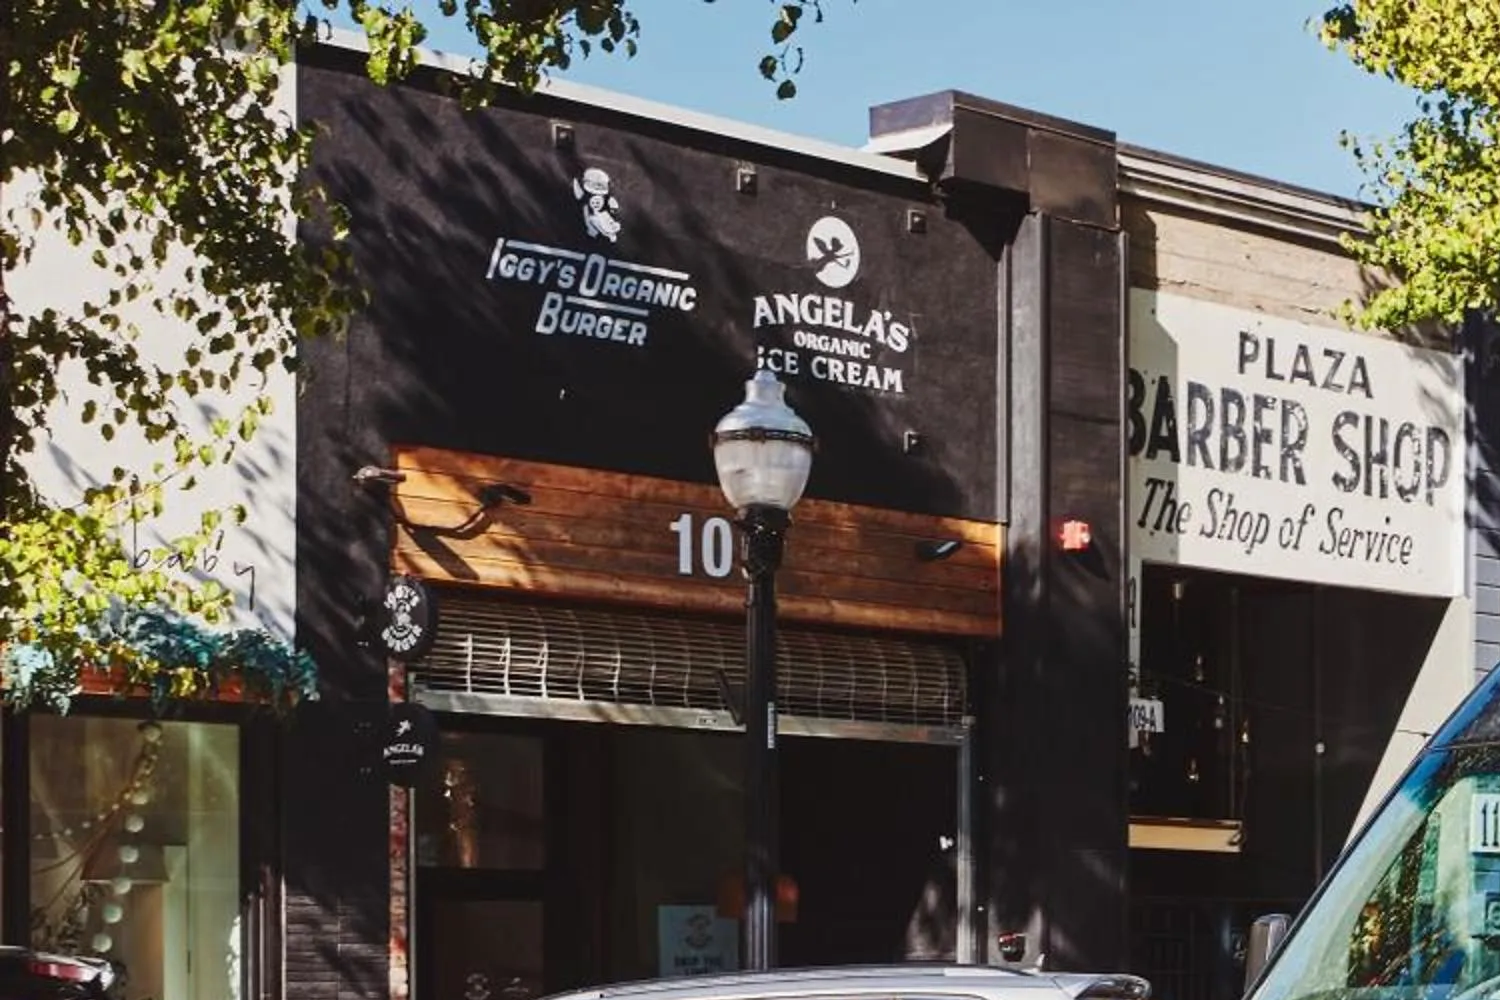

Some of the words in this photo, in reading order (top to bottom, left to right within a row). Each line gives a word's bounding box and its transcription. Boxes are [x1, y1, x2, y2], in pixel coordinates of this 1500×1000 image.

[579, 253, 697, 312] ORGANIC
[535, 292, 649, 346] BURGER
[753, 293, 909, 353] ANGELA'S
[793, 330, 871, 360] ORGANIC
[811, 355, 904, 393] CREAM
[1237, 331, 1374, 399] PLAZA
[1127, 368, 1309, 486] BARBER
[1331, 410, 1451, 506] SHOP
[1137, 477, 1191, 535] The
[1200, 487, 1271, 554] Shop
[1278, 502, 1316, 551] of
[1318, 507, 1414, 566] Service
